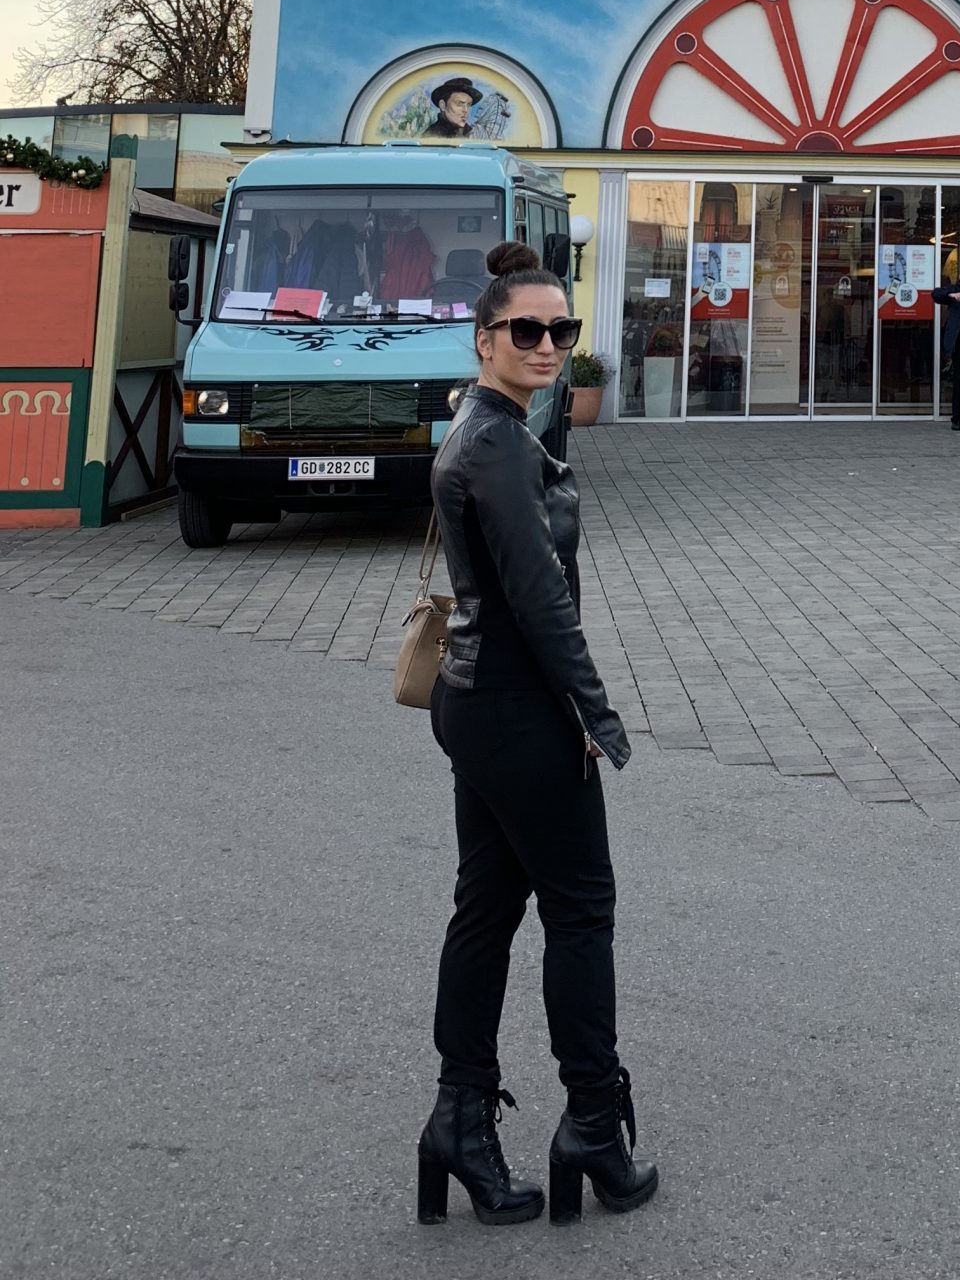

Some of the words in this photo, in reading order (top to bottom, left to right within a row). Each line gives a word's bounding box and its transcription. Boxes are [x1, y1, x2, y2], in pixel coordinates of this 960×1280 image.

[301, 462, 317, 474] GD
[327, 461, 350, 474] 282
[353, 461, 370, 473] CC
